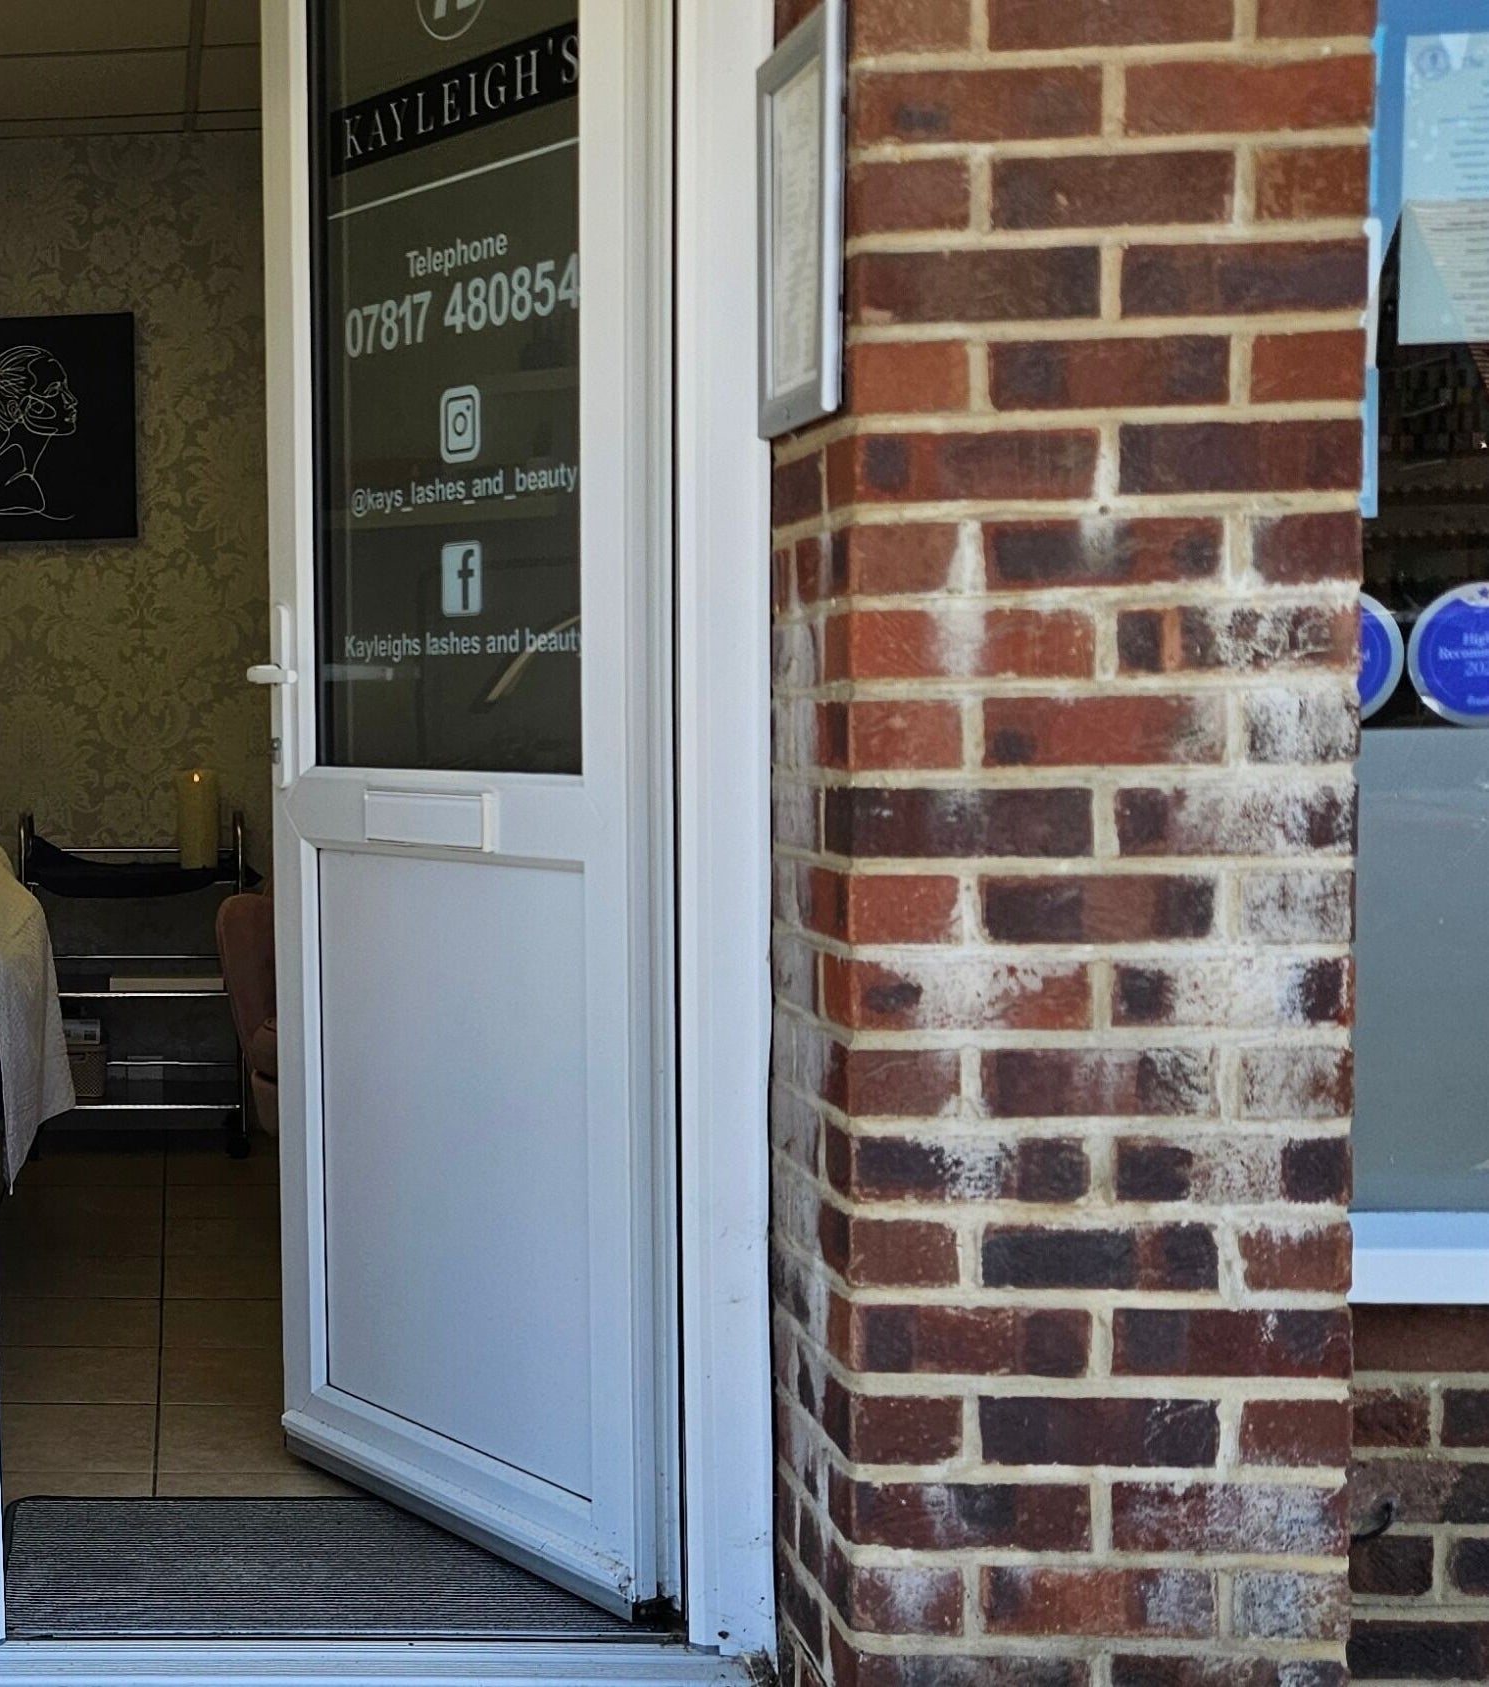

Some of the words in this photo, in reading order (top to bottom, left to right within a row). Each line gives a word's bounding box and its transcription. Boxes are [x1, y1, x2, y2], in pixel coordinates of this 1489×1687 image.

[343, 34, 579, 160] KAYLEIGH'S
[406, 232, 509, 279] Telephone
[344, 289, 433, 359] 07817
[443, 252, 579, 335] 480854
[350, 462, 578, 518] @kays_lashes_and_beauty
[344, 633, 421, 663] Kayleighs
[425, 631, 481, 656] lashes
[486, 628, 520, 655] and
